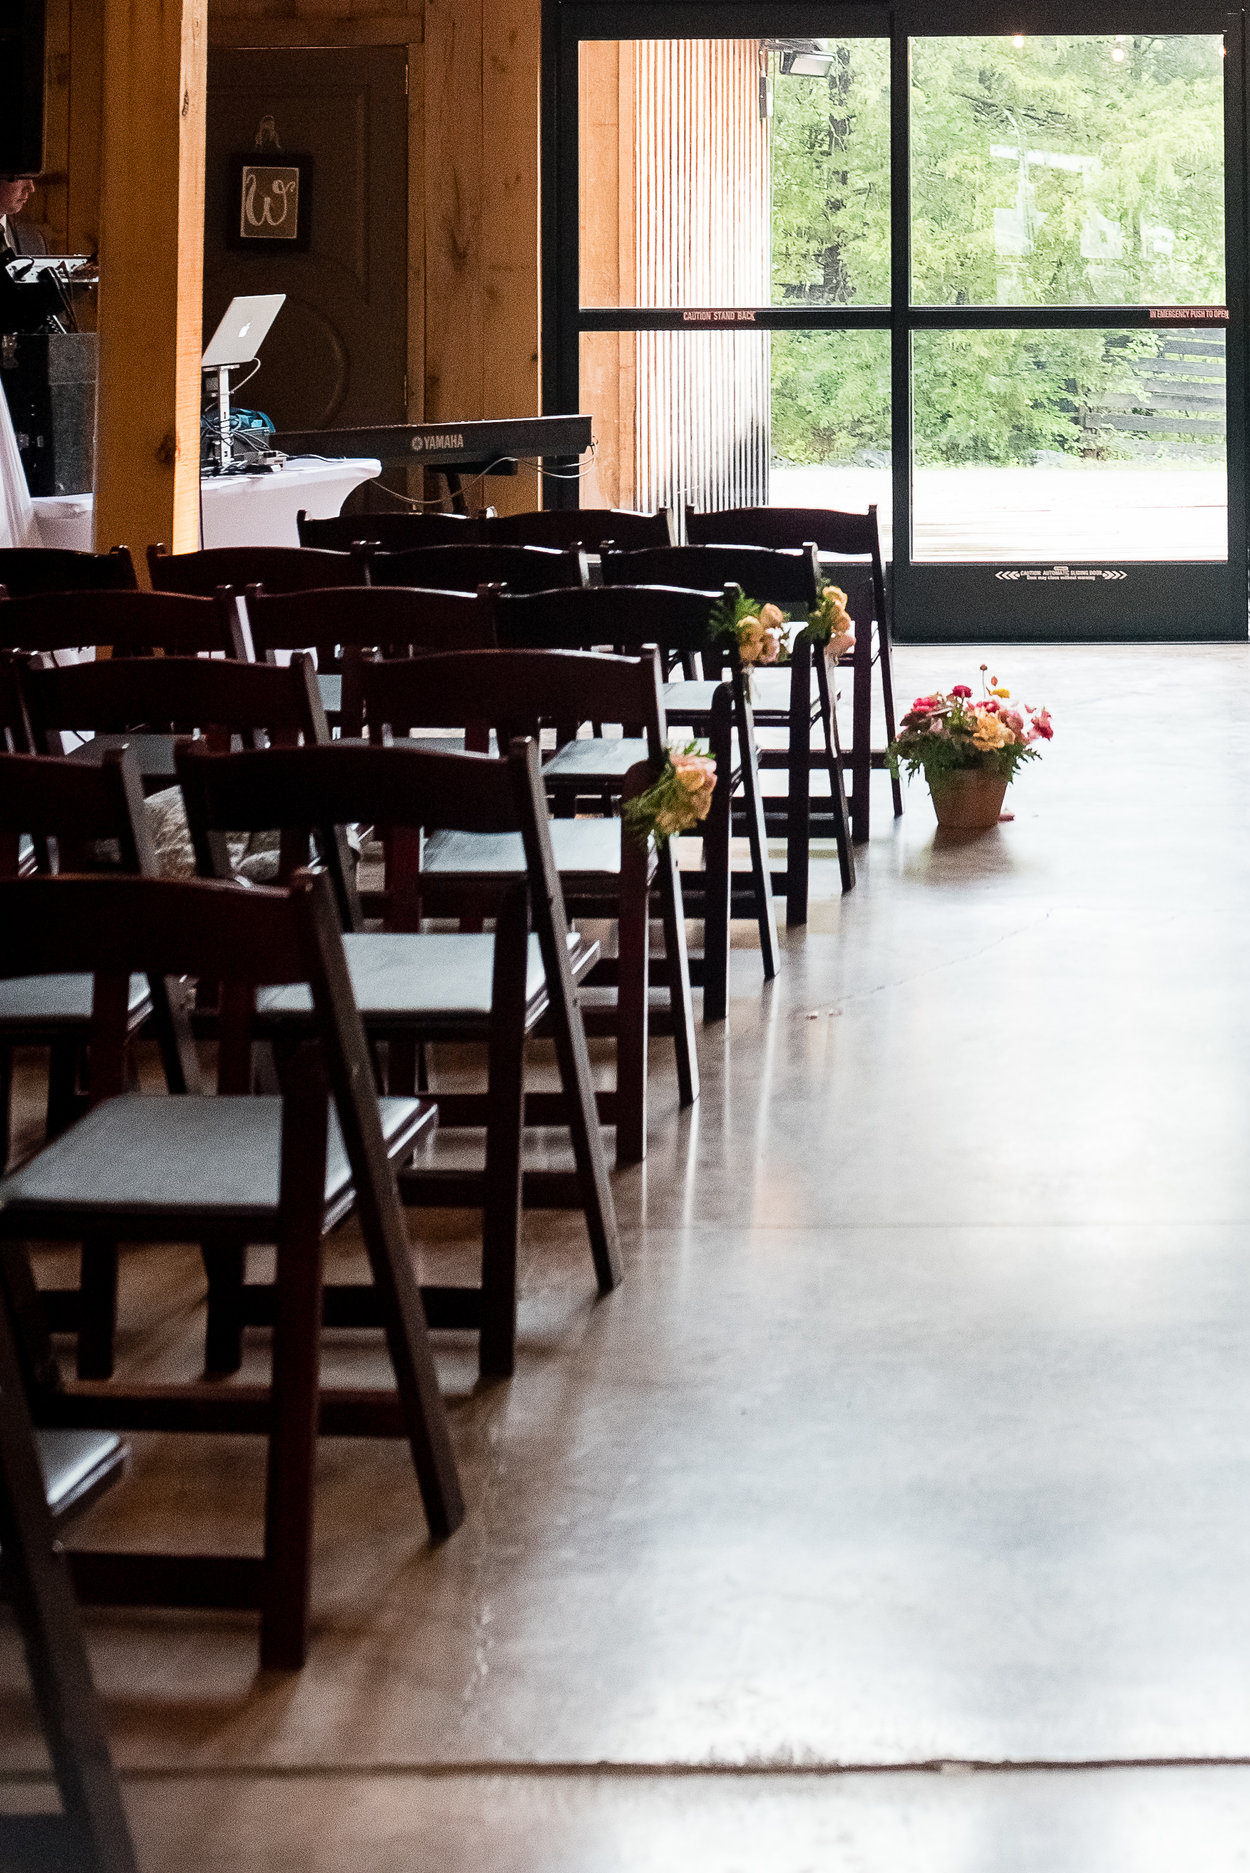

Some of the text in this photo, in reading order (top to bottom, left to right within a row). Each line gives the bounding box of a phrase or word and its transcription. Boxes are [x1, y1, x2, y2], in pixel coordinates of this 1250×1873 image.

[683, 310, 756, 321] CAUTION STAND BACK
[1157, 309, 1190, 318] EMERGENCY
[1191, 309, 1205, 318] PUSH
[1206, 309, 1213, 318] TO
[1214, 309, 1230, 319] OPEN
[424, 434, 464, 449] YAMAHA
